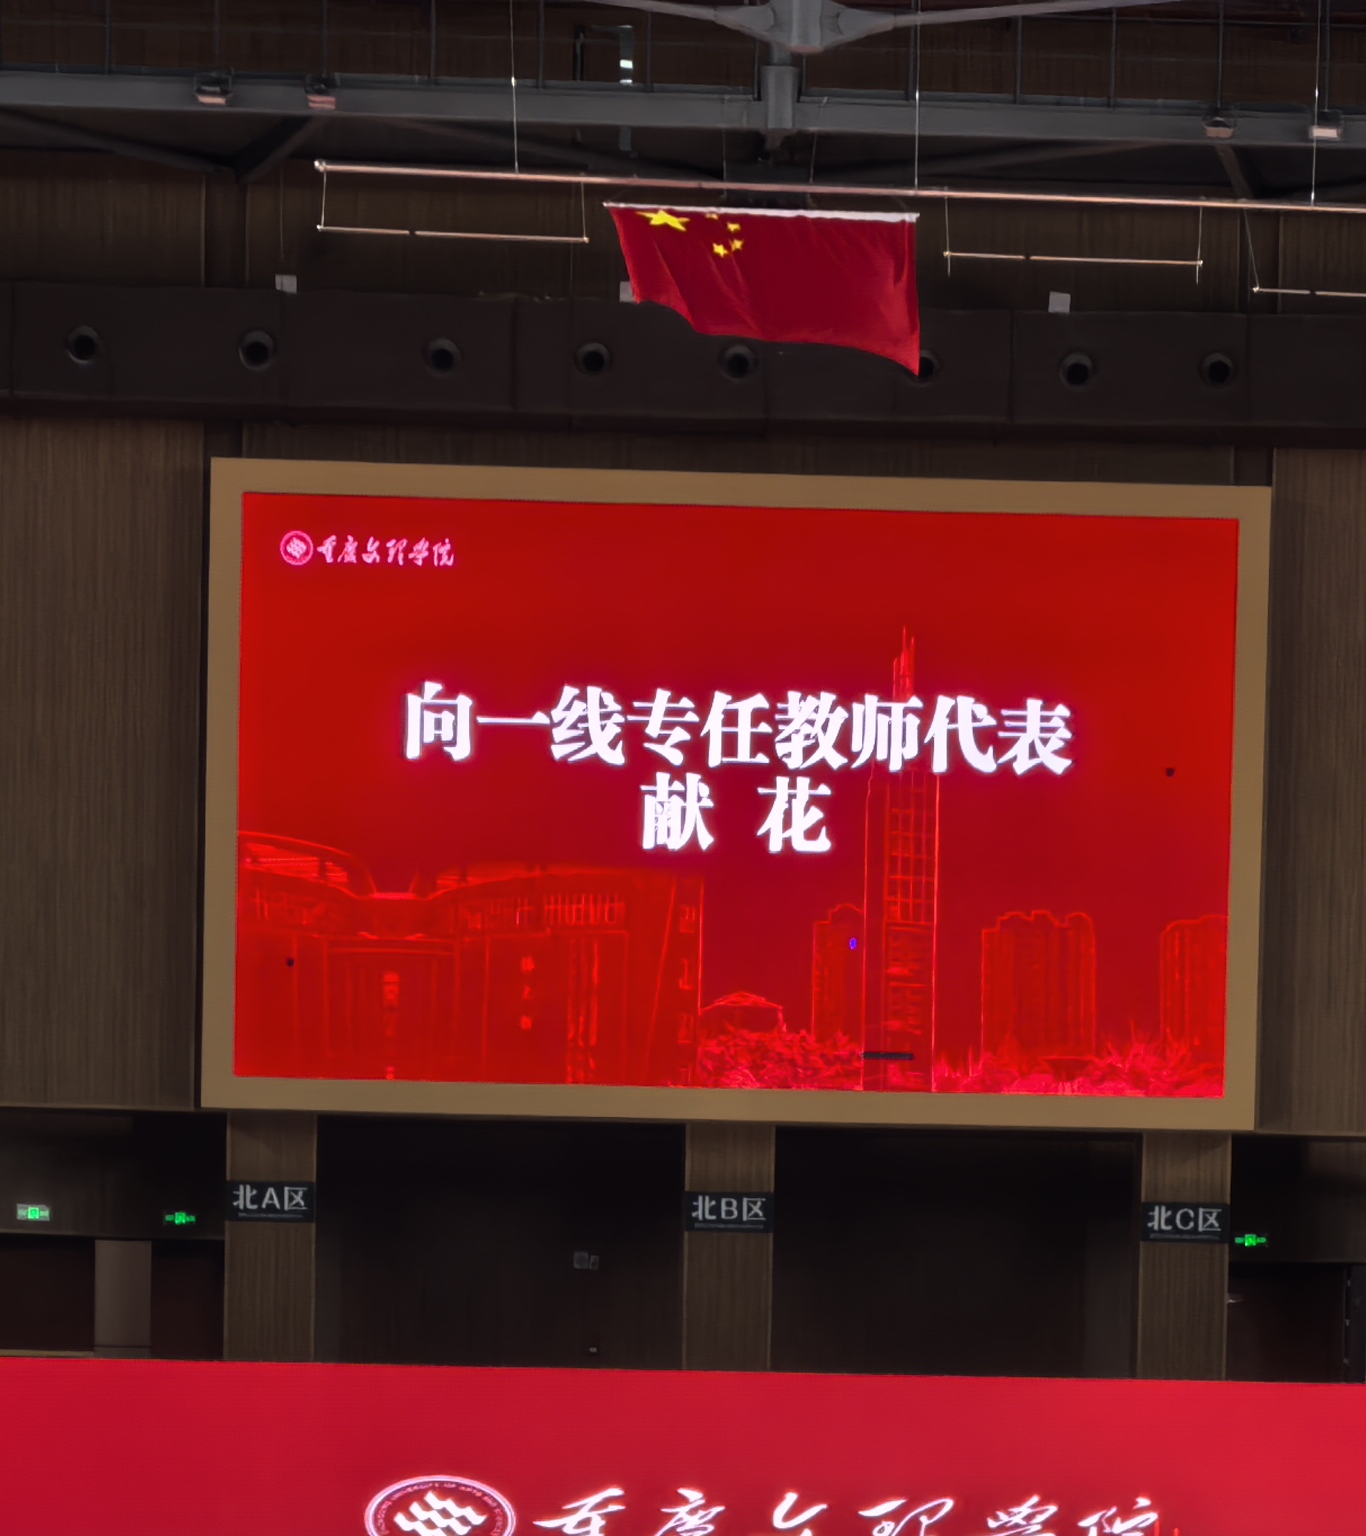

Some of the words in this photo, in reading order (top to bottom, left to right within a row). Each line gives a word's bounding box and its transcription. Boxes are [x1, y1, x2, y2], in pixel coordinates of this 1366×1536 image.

[404, 680, 1075, 776] 向一线专任教师代表
[232, 1184, 308, 1211] 北A区
[691, 1195, 766, 1222] 北B区
[1146, 1205, 1222, 1232] 北C区
